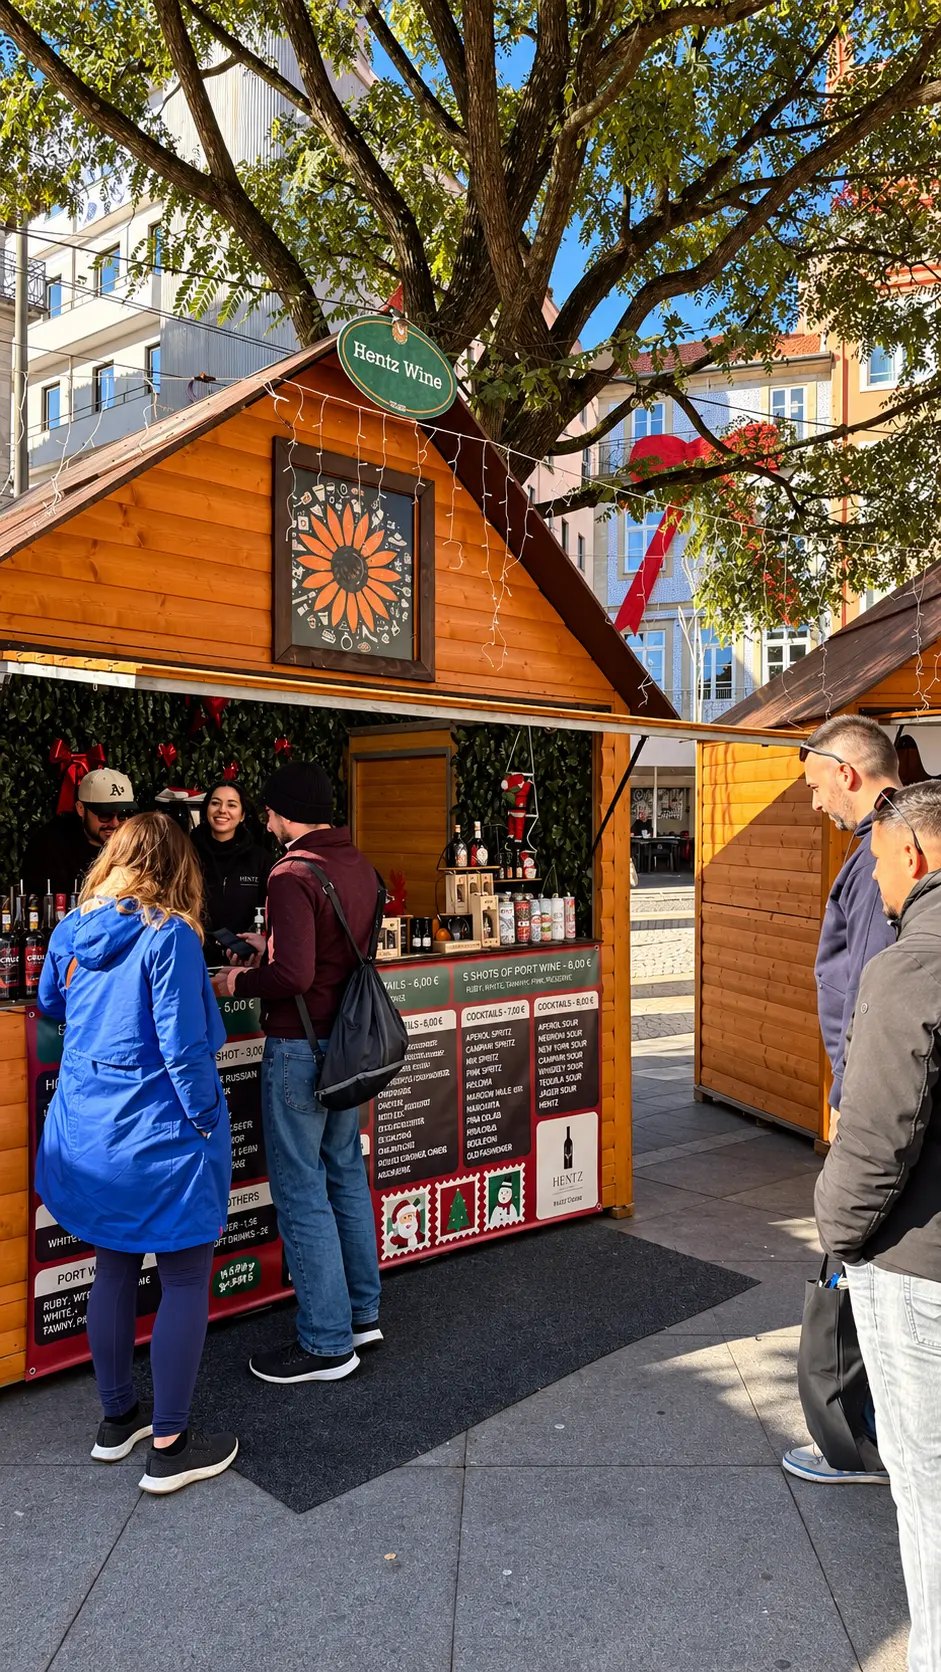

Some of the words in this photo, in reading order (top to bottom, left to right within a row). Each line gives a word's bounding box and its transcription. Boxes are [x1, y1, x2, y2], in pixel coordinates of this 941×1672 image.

[353, 340, 400, 373] Hentz
[402, 359, 442, 389] Wine
[470, 968, 500, 981] SHOTS
[501, 966, 513, 977] OF
[514, 963, 538, 975] PORT
[538, 959, 561, 972] WINE
[586, 958, 592, 967] €
[413, 977, 432, 989] 6,00
[433, 975, 439, 986] €
[248, 999, 255, 1010] €
[537, 999, 572, 1011] COCKTAILS
[590, 995, 594, 1005] €
[438, 1016, 443, 1026] €
[466, 1008, 503, 1021] COCKTAILS
[507, 1007, 520, 1018] 7,00
[521, 1005, 526, 1014] €
[225, 1069, 258, 1084] RUSSIAN
[552, 1171, 584, 1188] HENTZ
[57, 1267, 87, 1286] PORT
